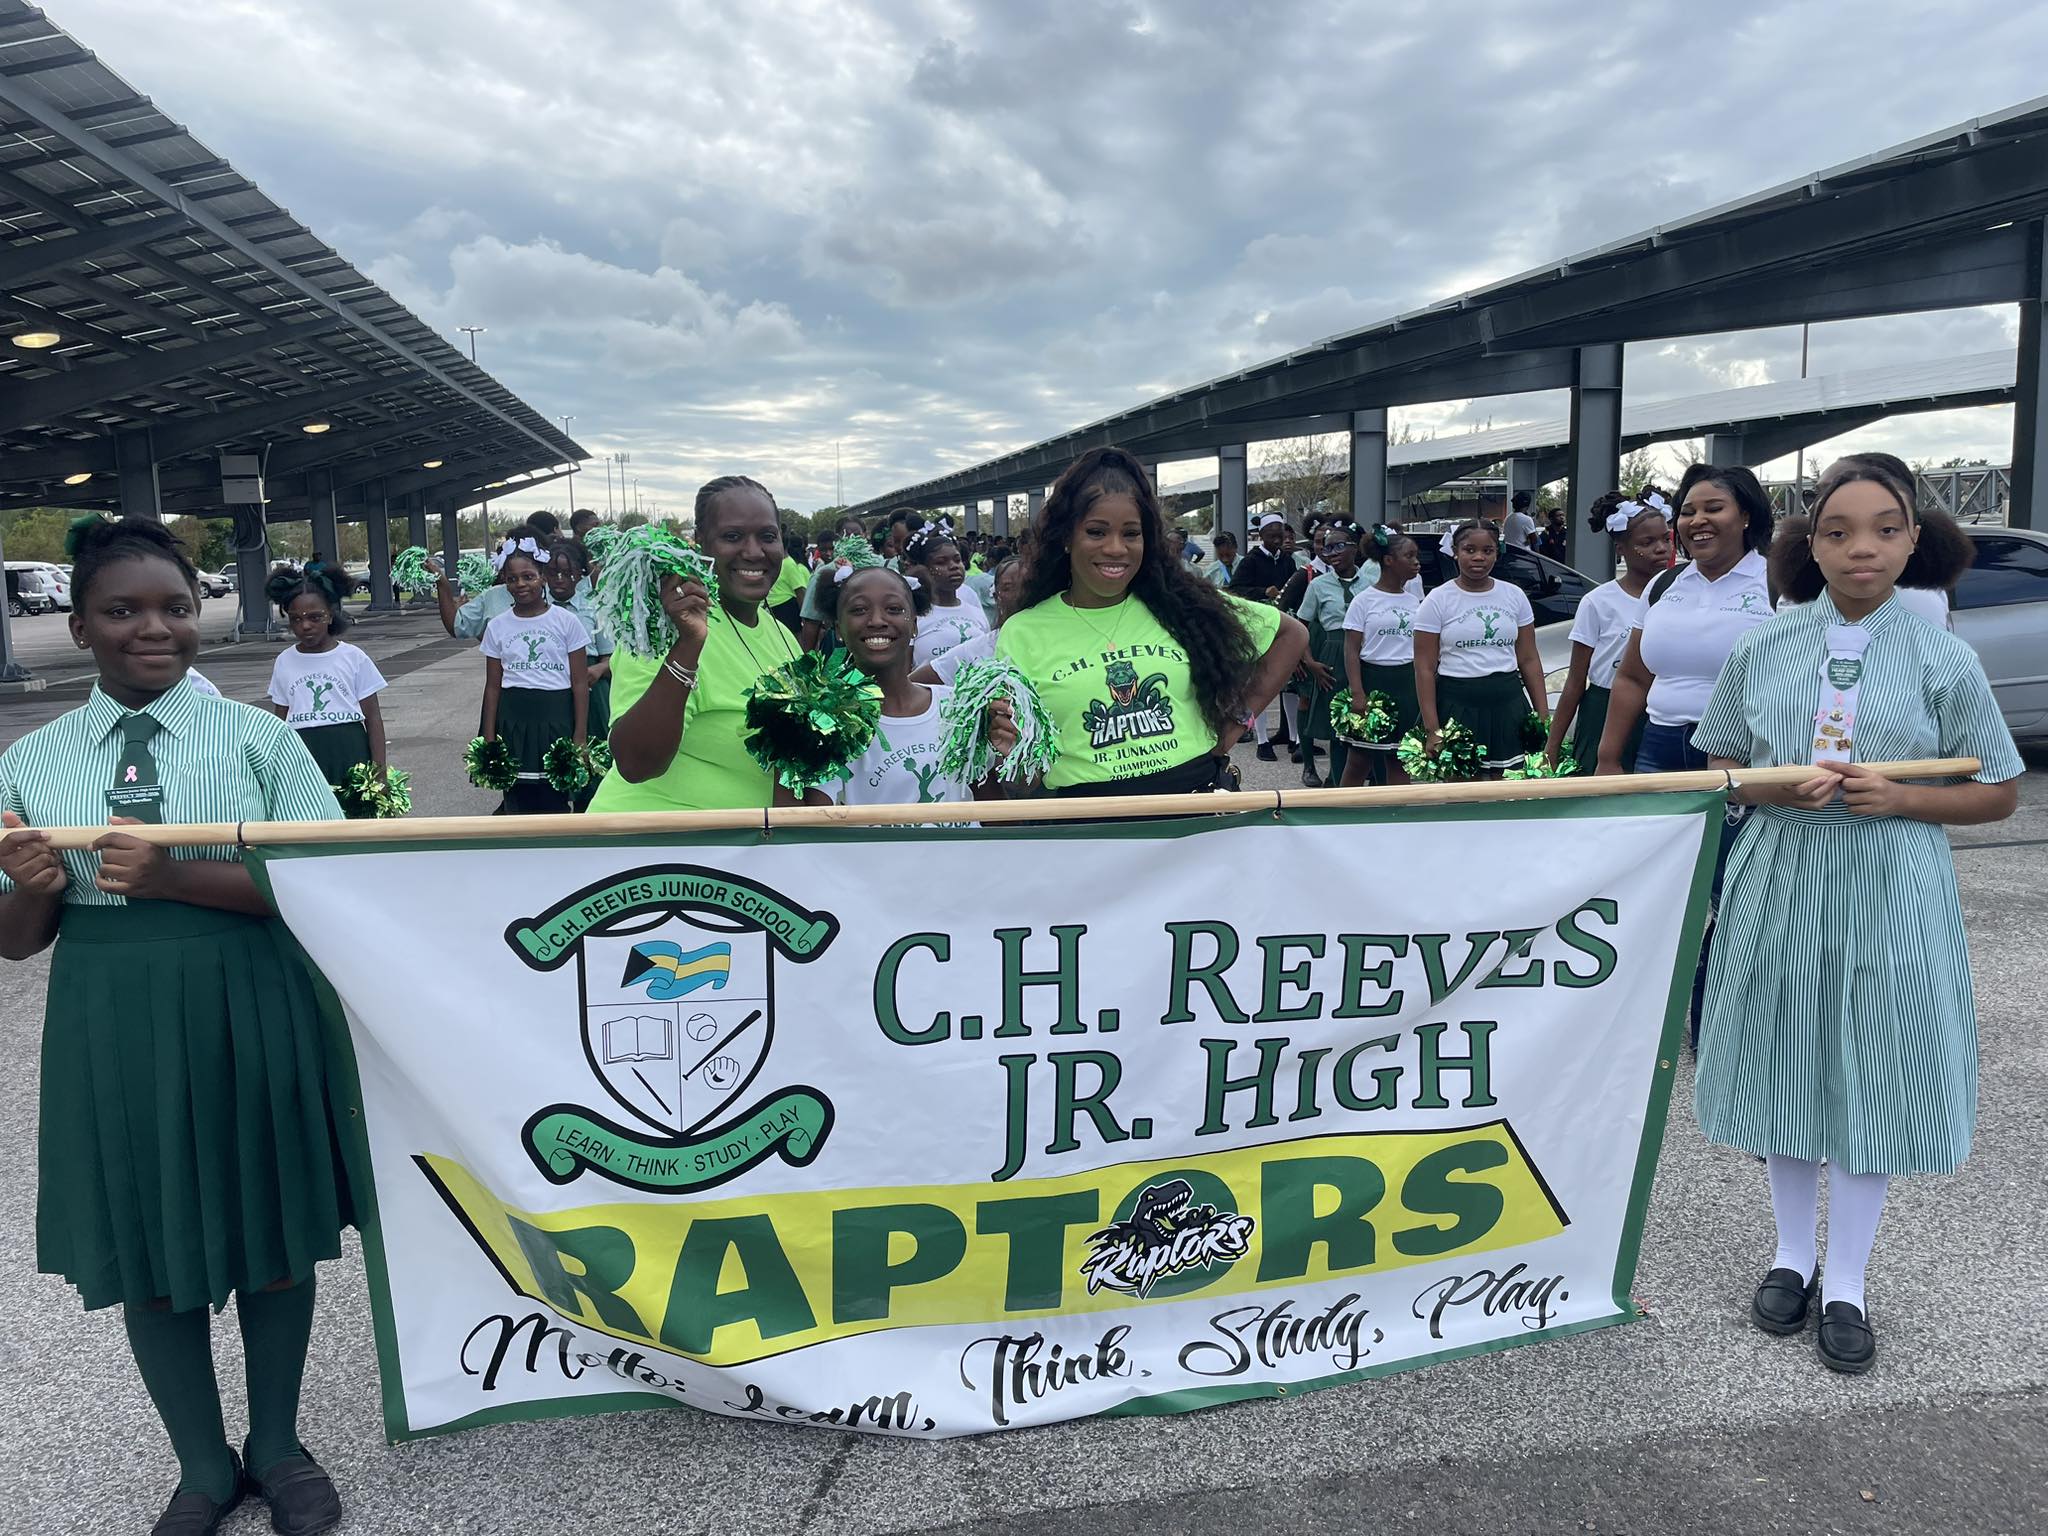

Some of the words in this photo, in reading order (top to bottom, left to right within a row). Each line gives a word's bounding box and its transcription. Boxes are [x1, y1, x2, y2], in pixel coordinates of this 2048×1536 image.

[1378, 628, 1401, 636] CHEER
[1455, 640, 1488, 649] CHEER
[534, 662, 565, 672] SQUAD
[1052, 658, 1095, 682] C.H.
[1100, 644, 1183, 663] REEVES
[320, 711, 361, 723] SQUAD
[1091, 708, 1174, 748] RAPTORS
[1092, 752, 1112, 764] JR.
[1115, 738, 1179, 761] JUNKANOO
[1112, 757, 1168, 774] CHAMPIONS
[548, 914, 584, 949] C.H.
[582, 883, 653, 923] REEVES
[658, 880, 728, 903] JUNIOR
[730, 891, 797, 945] SCHOOL
[873, 924, 1121, 1045] C.H.
[1160, 897, 1619, 1025] REEVES
[991, 1050, 1153, 1182] JR.
[1195, 1020, 1498, 1136] HIGH
[555, 1125, 614, 1164] LEARN
[627, 1154, 680, 1176] THINK
[694, 1137, 751, 1172] STUDY
[759, 1105, 802, 1141] PLAY
[507, 1140, 1509, 1354] RAPTORS
[460, 1312, 686, 1393] Motto:
[722, 1384, 936, 1432] Learn,
[960, 1324, 1153, 1426] Think,
[1178, 1294, 1384, 1376] Study,
[1413, 1262, 1570, 1340] Play.
